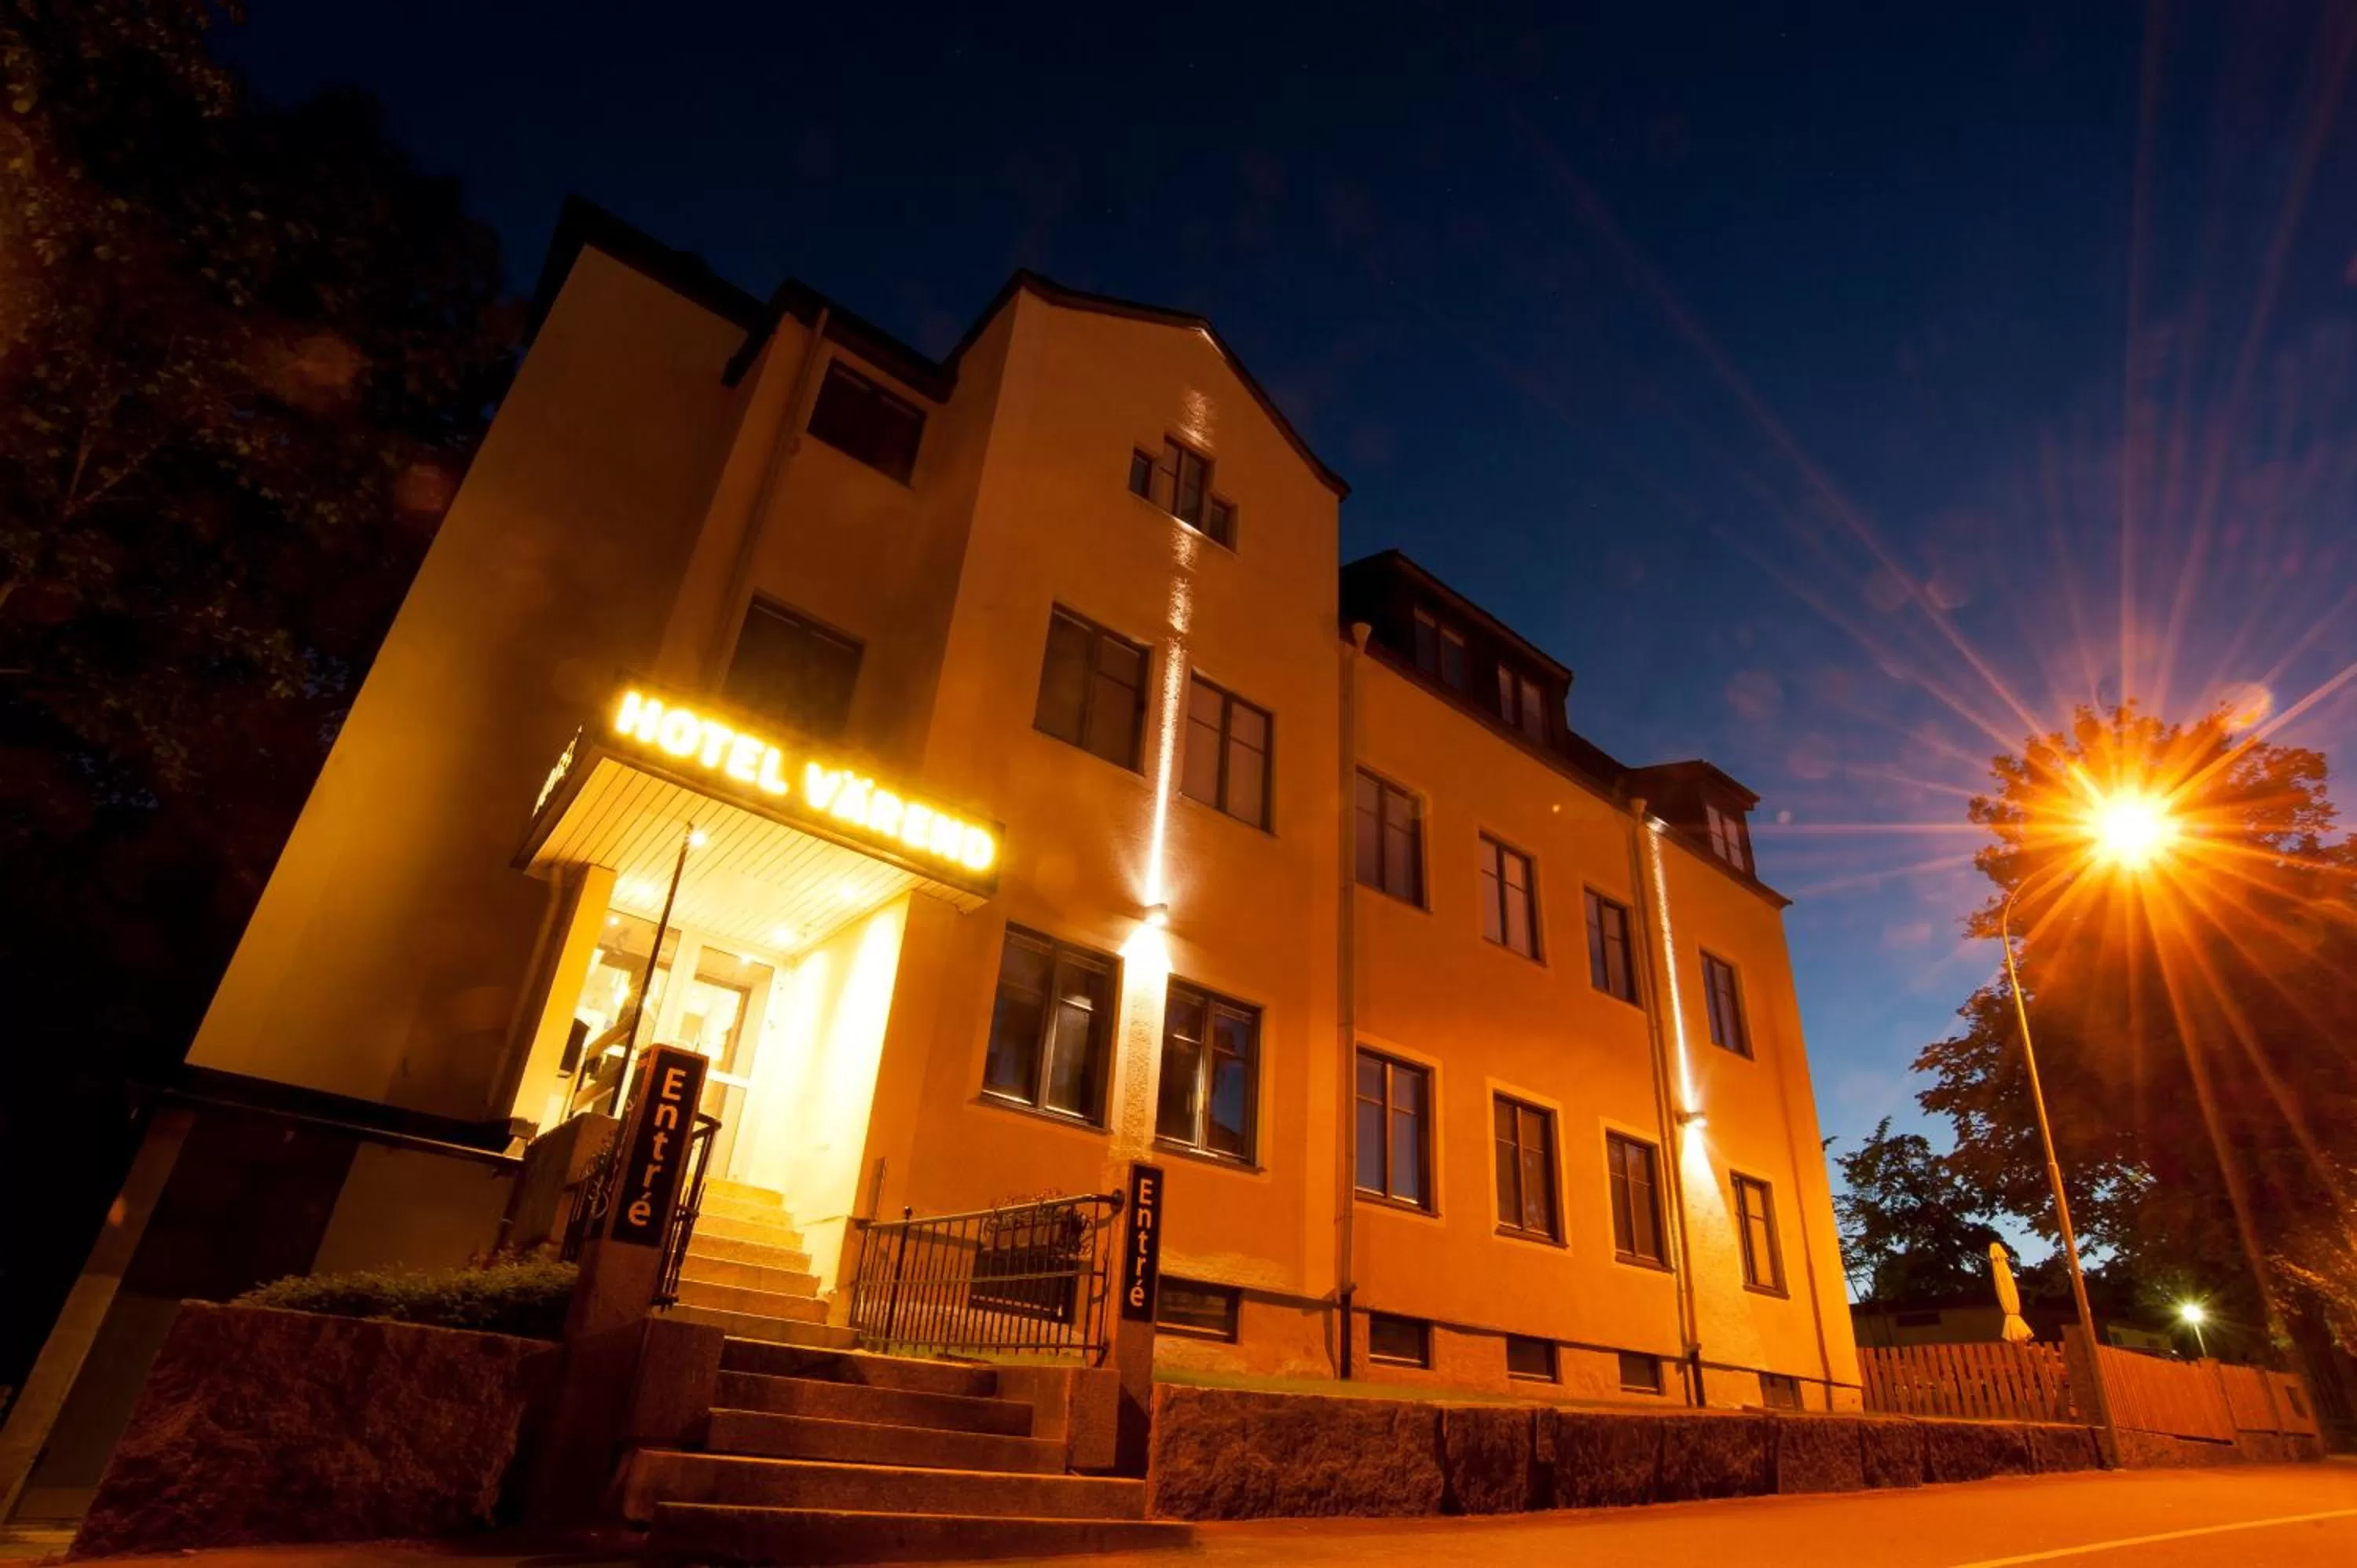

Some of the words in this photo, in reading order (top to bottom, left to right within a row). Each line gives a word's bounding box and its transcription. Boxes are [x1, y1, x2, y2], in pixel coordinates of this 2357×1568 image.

[616, 692, 786, 793] HOTEL
[806, 763, 993, 869] VÄREND
[628, 1067, 687, 1226] Entré
[1129, 1178, 1153, 1308] Entré
